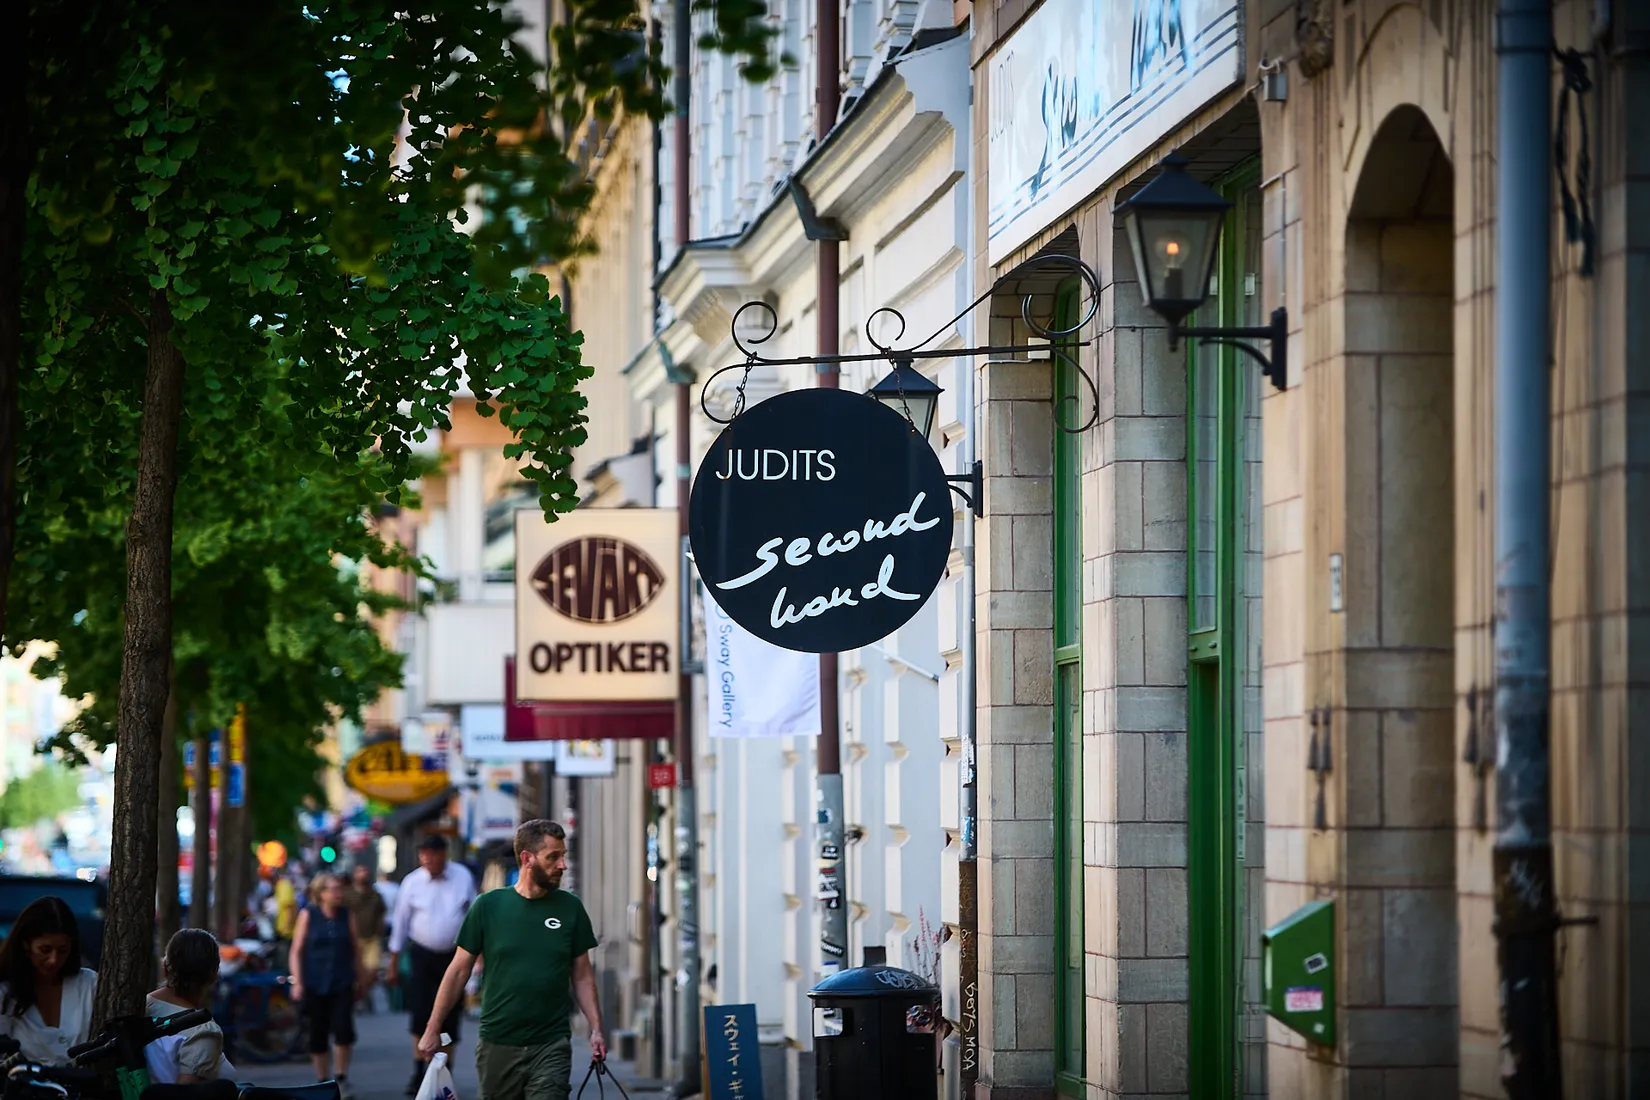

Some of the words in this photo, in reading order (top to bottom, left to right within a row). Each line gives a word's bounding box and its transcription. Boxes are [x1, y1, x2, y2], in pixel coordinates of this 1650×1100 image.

[715, 448, 837, 482] JUDITS
[770, 553, 922, 629] hand
[529, 641, 671, 674] OPTIKER
[717, 624, 733, 667] Sway
[718, 670, 736, 728] Gallery
[544, 917, 562, 930] G
